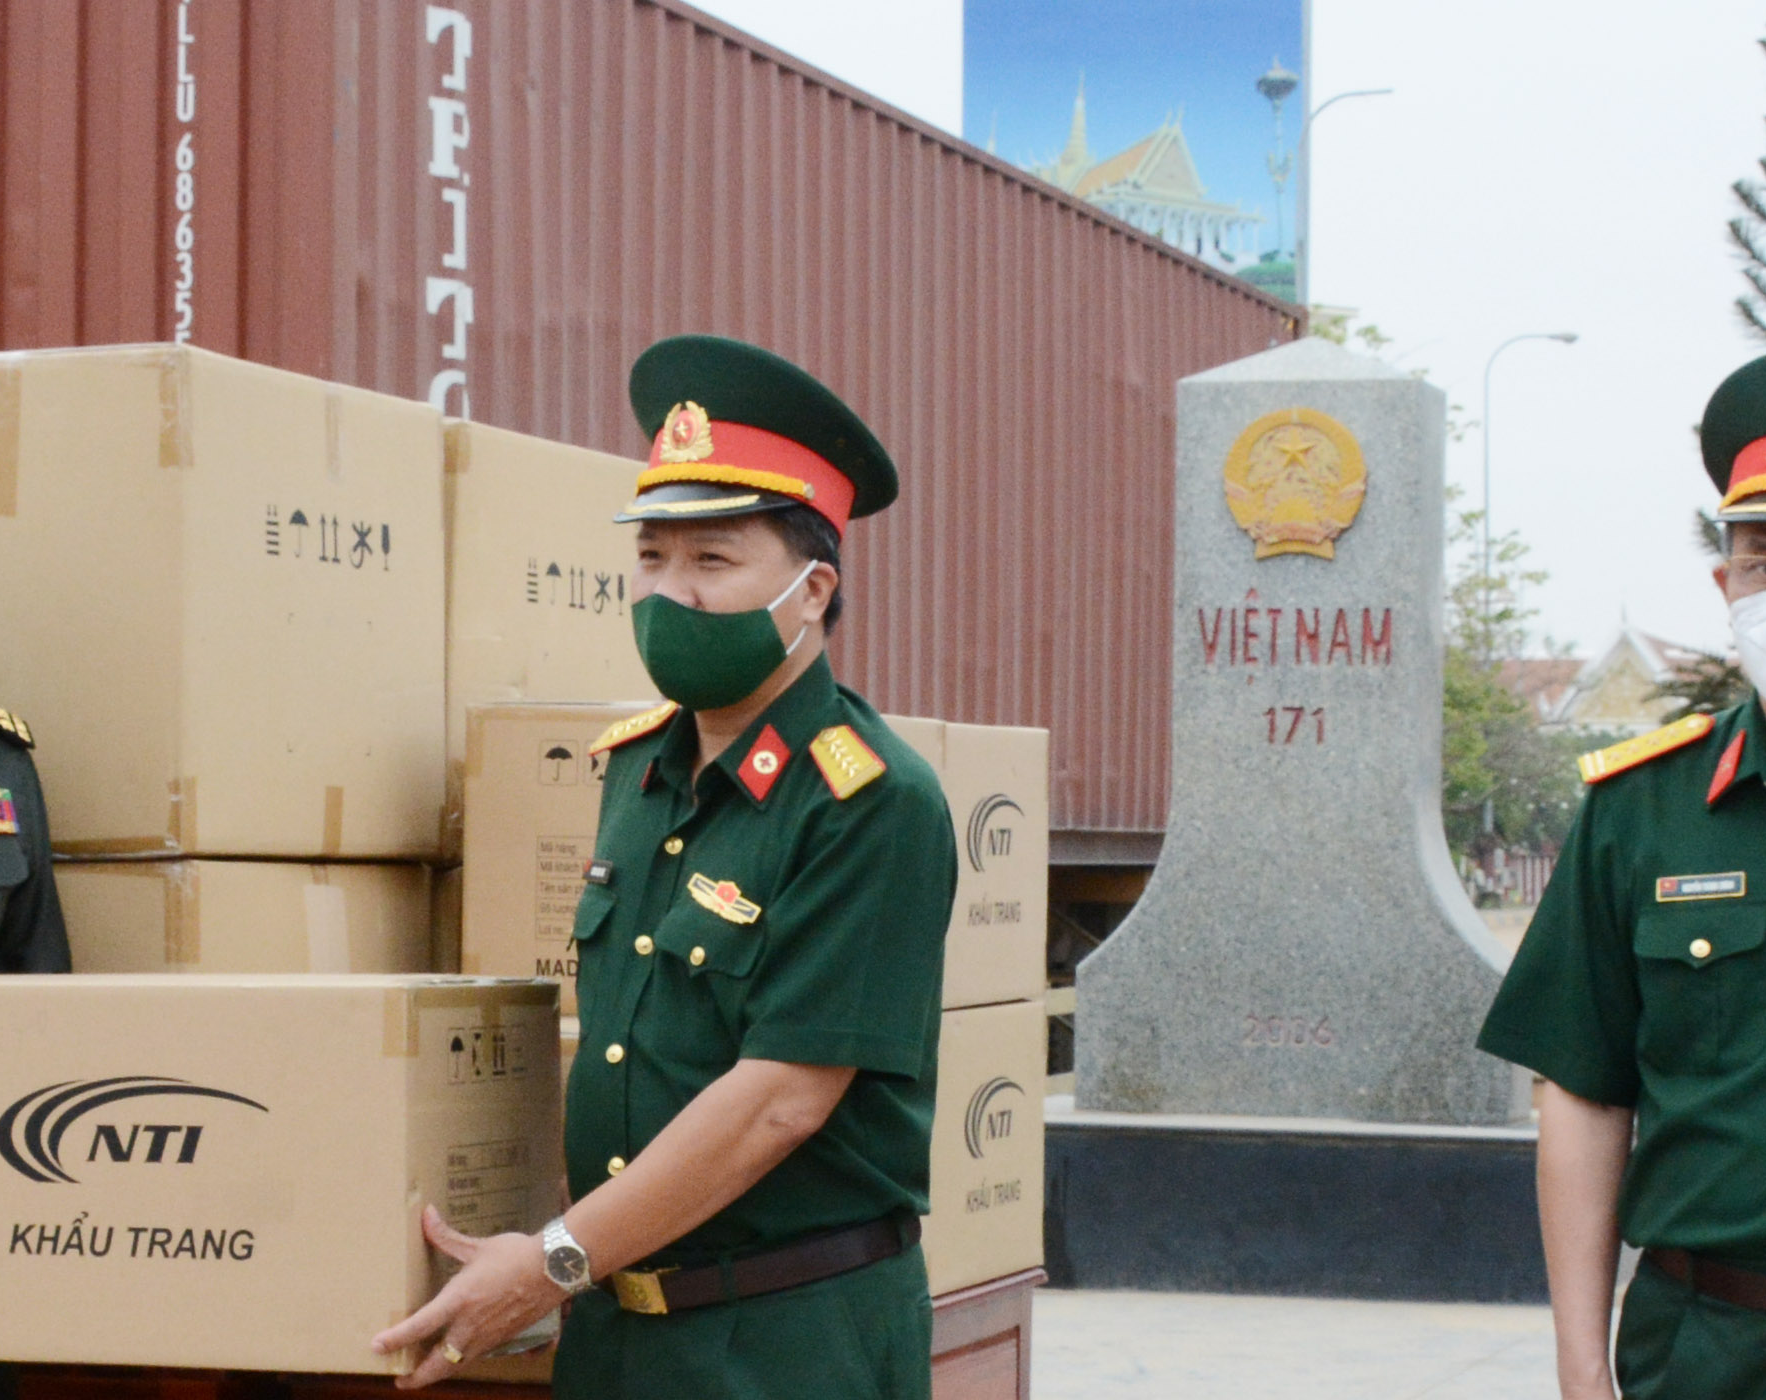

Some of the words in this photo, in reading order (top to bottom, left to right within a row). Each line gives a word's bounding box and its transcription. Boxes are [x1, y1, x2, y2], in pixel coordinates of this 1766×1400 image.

[177, 0, 195, 122] LLU
[1198, 587, 1282, 686] VIỆT
[1295, 607, 1393, 667] NAM
[1262, 706, 1326, 745] 171
[987, 827, 1012, 857] NTI
[1243, 1013, 1334, 1048] 2006
[85, 1124, 204, 1164] NTI
[986, 1109, 1012, 1141] NTI
[8, 1211, 114, 1257] KHẨU
[127, 1226, 255, 1261] TRANG
